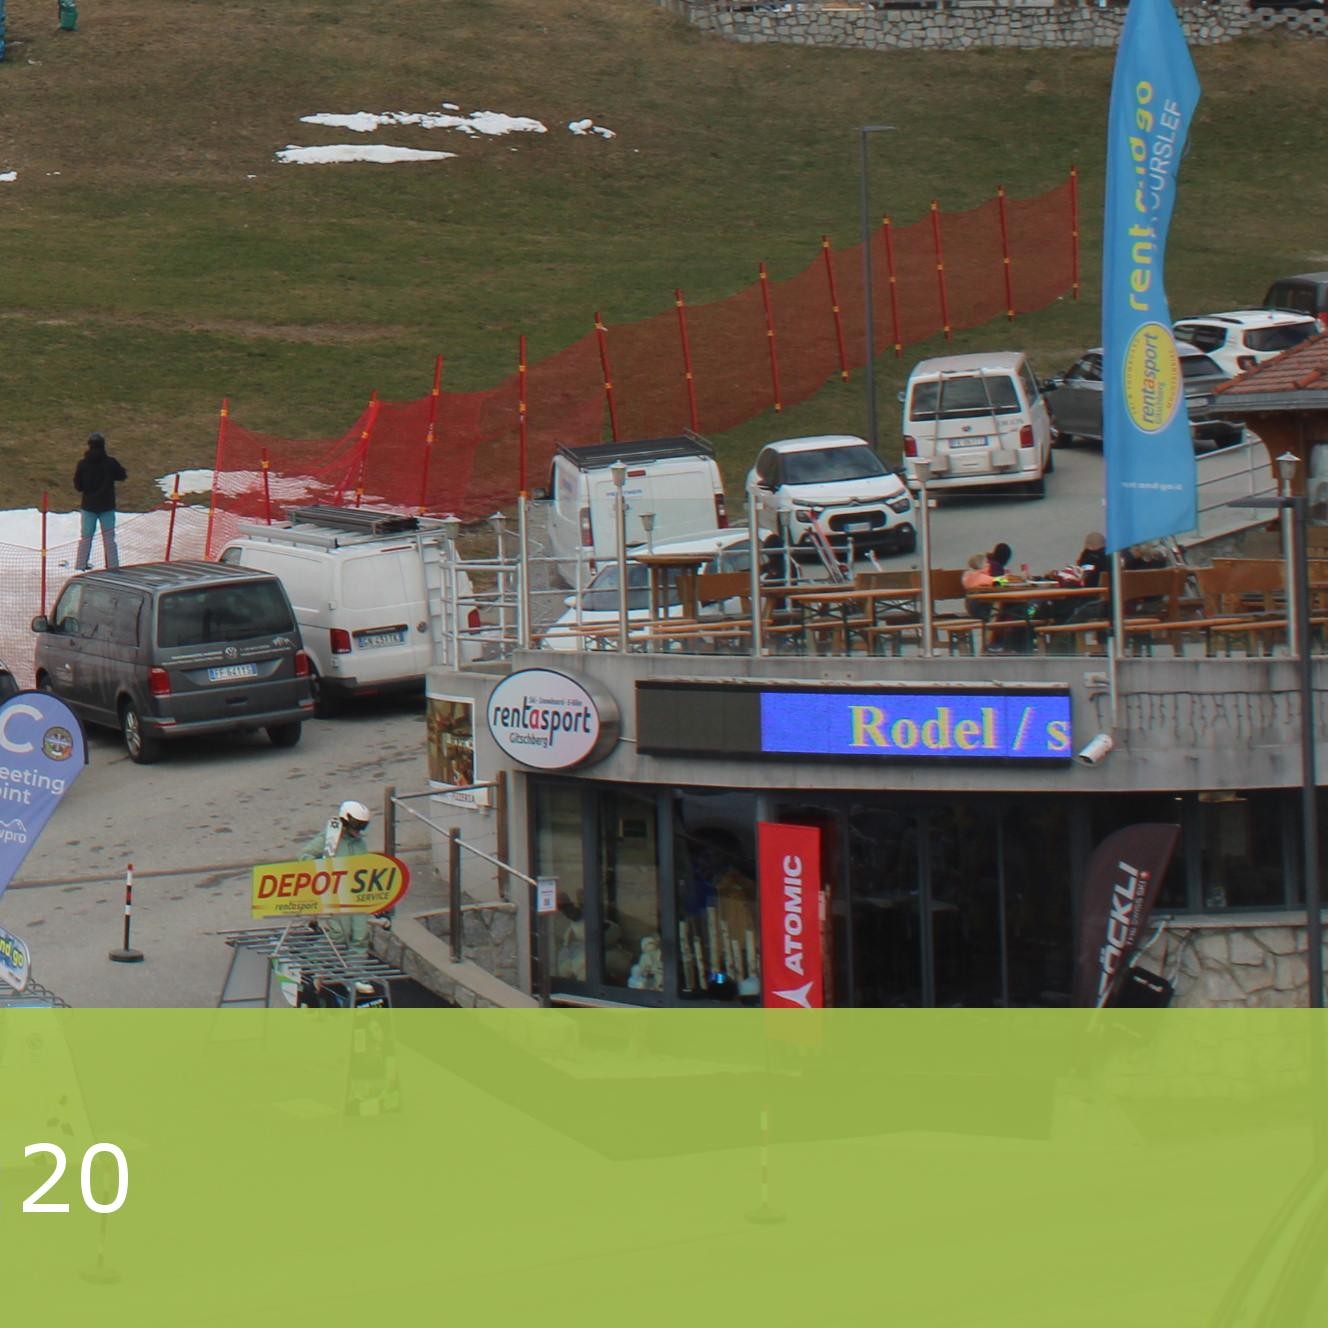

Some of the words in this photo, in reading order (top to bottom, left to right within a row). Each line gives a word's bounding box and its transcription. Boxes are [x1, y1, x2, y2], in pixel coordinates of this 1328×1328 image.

[1136, 81, 1153, 132] go
[1128, 223, 1155, 311] rent
[1142, 333, 1159, 424] rentasport
[493, 696, 591, 747] rentasport
[509, 732, 549, 748] Gitschberg
[848, 705, 1004, 750] Rodel
[258, 870, 349, 899] DEPOT
[350, 867, 397, 894] SKI
[356, 891, 390, 903] SERVICE
[275, 900, 319, 913] rentasport
[782, 855, 804, 976] ATOMIC
[12, 948, 24, 967] go
